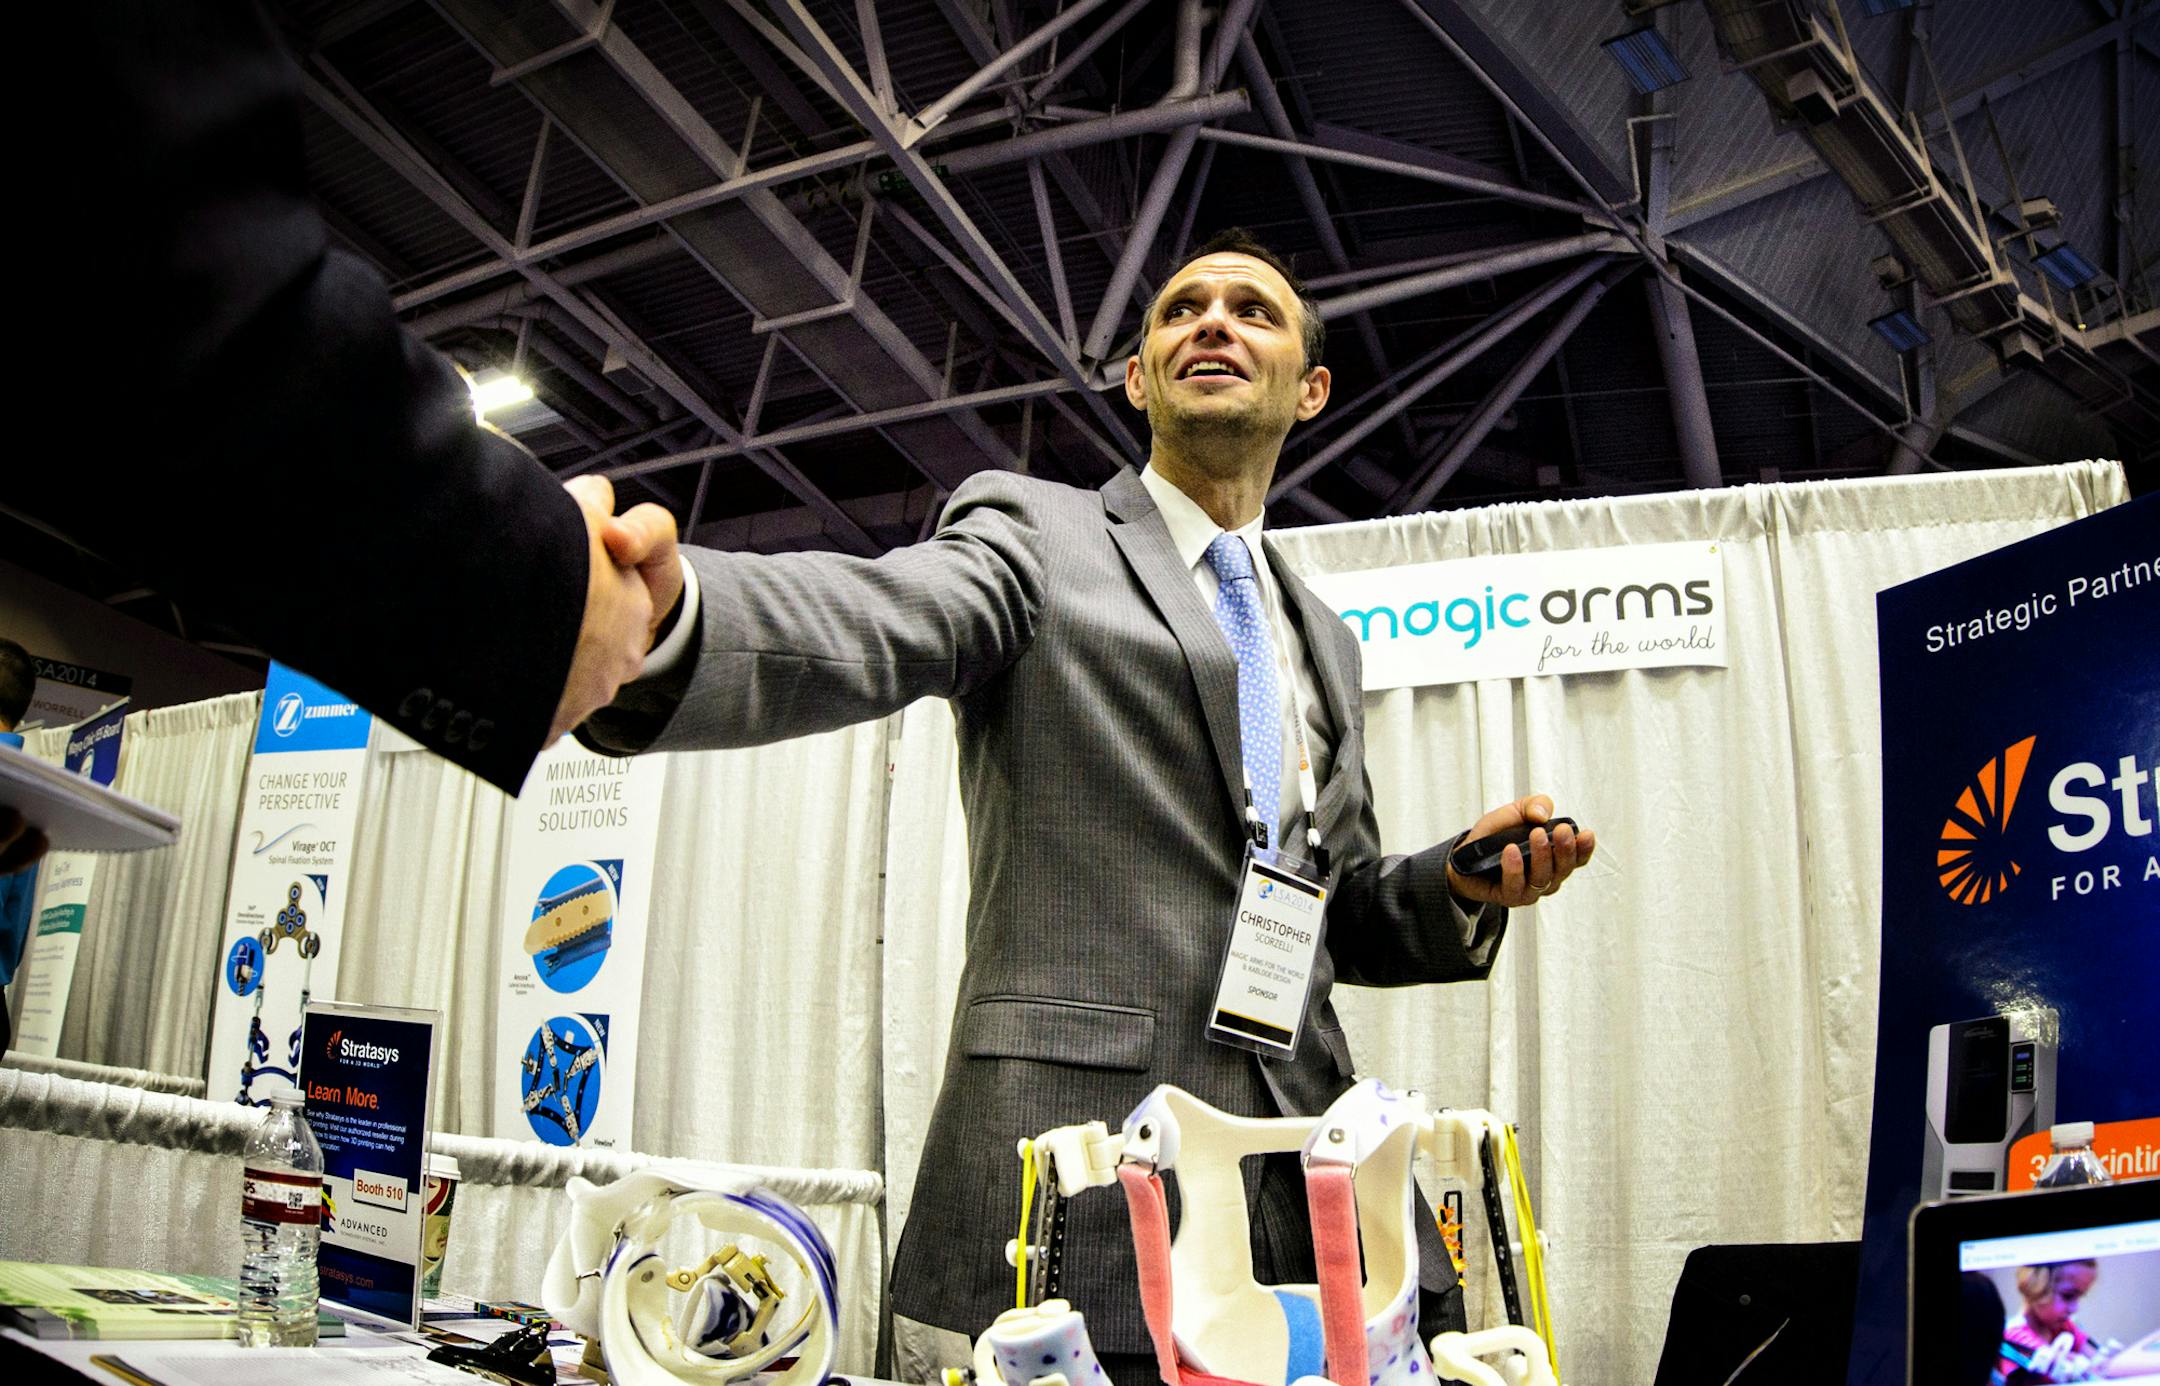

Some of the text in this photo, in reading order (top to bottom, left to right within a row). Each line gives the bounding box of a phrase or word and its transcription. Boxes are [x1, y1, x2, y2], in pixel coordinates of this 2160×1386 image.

[1341, 580, 1713, 650] magic arms
[1926, 593, 2057, 653] Strategic
[1537, 626, 1716, 672] for the world
[33, 659, 97, 687] SA2014
[259, 772, 347, 790] CHANGE YOUR
[547, 757, 633, 782] MINIMALLY
[259, 794, 340, 810] PERSPECTIVE
[550, 782, 622, 806] INVASIVE
[2048, 755, 2160, 853] St
[539, 807, 628, 832] SOLUTIONS
[320, 842, 336, 852] OCT
[269, 856, 334, 866] Spinal Fixation System
[2052, 856, 2160, 900] FOR A
[1241, 910, 1312, 946] CHRISTOPHER
[1255, 932, 1294, 953] SCORZELLI
[1248, 986, 1278, 1001] SPONSOR
[594, 1018, 606, 1038] NEW
[341, 1039, 399, 1066] Stratasys
[308, 1080, 380, 1110] Learn More.
[325, 1112, 345, 1123] Stratasys
[377, 1122, 407, 1133] professional
[389, 1134, 405, 1144] during
[357, 1179, 403, 1200] Booth 510
[341, 1218, 388, 1238] ADVANCED
